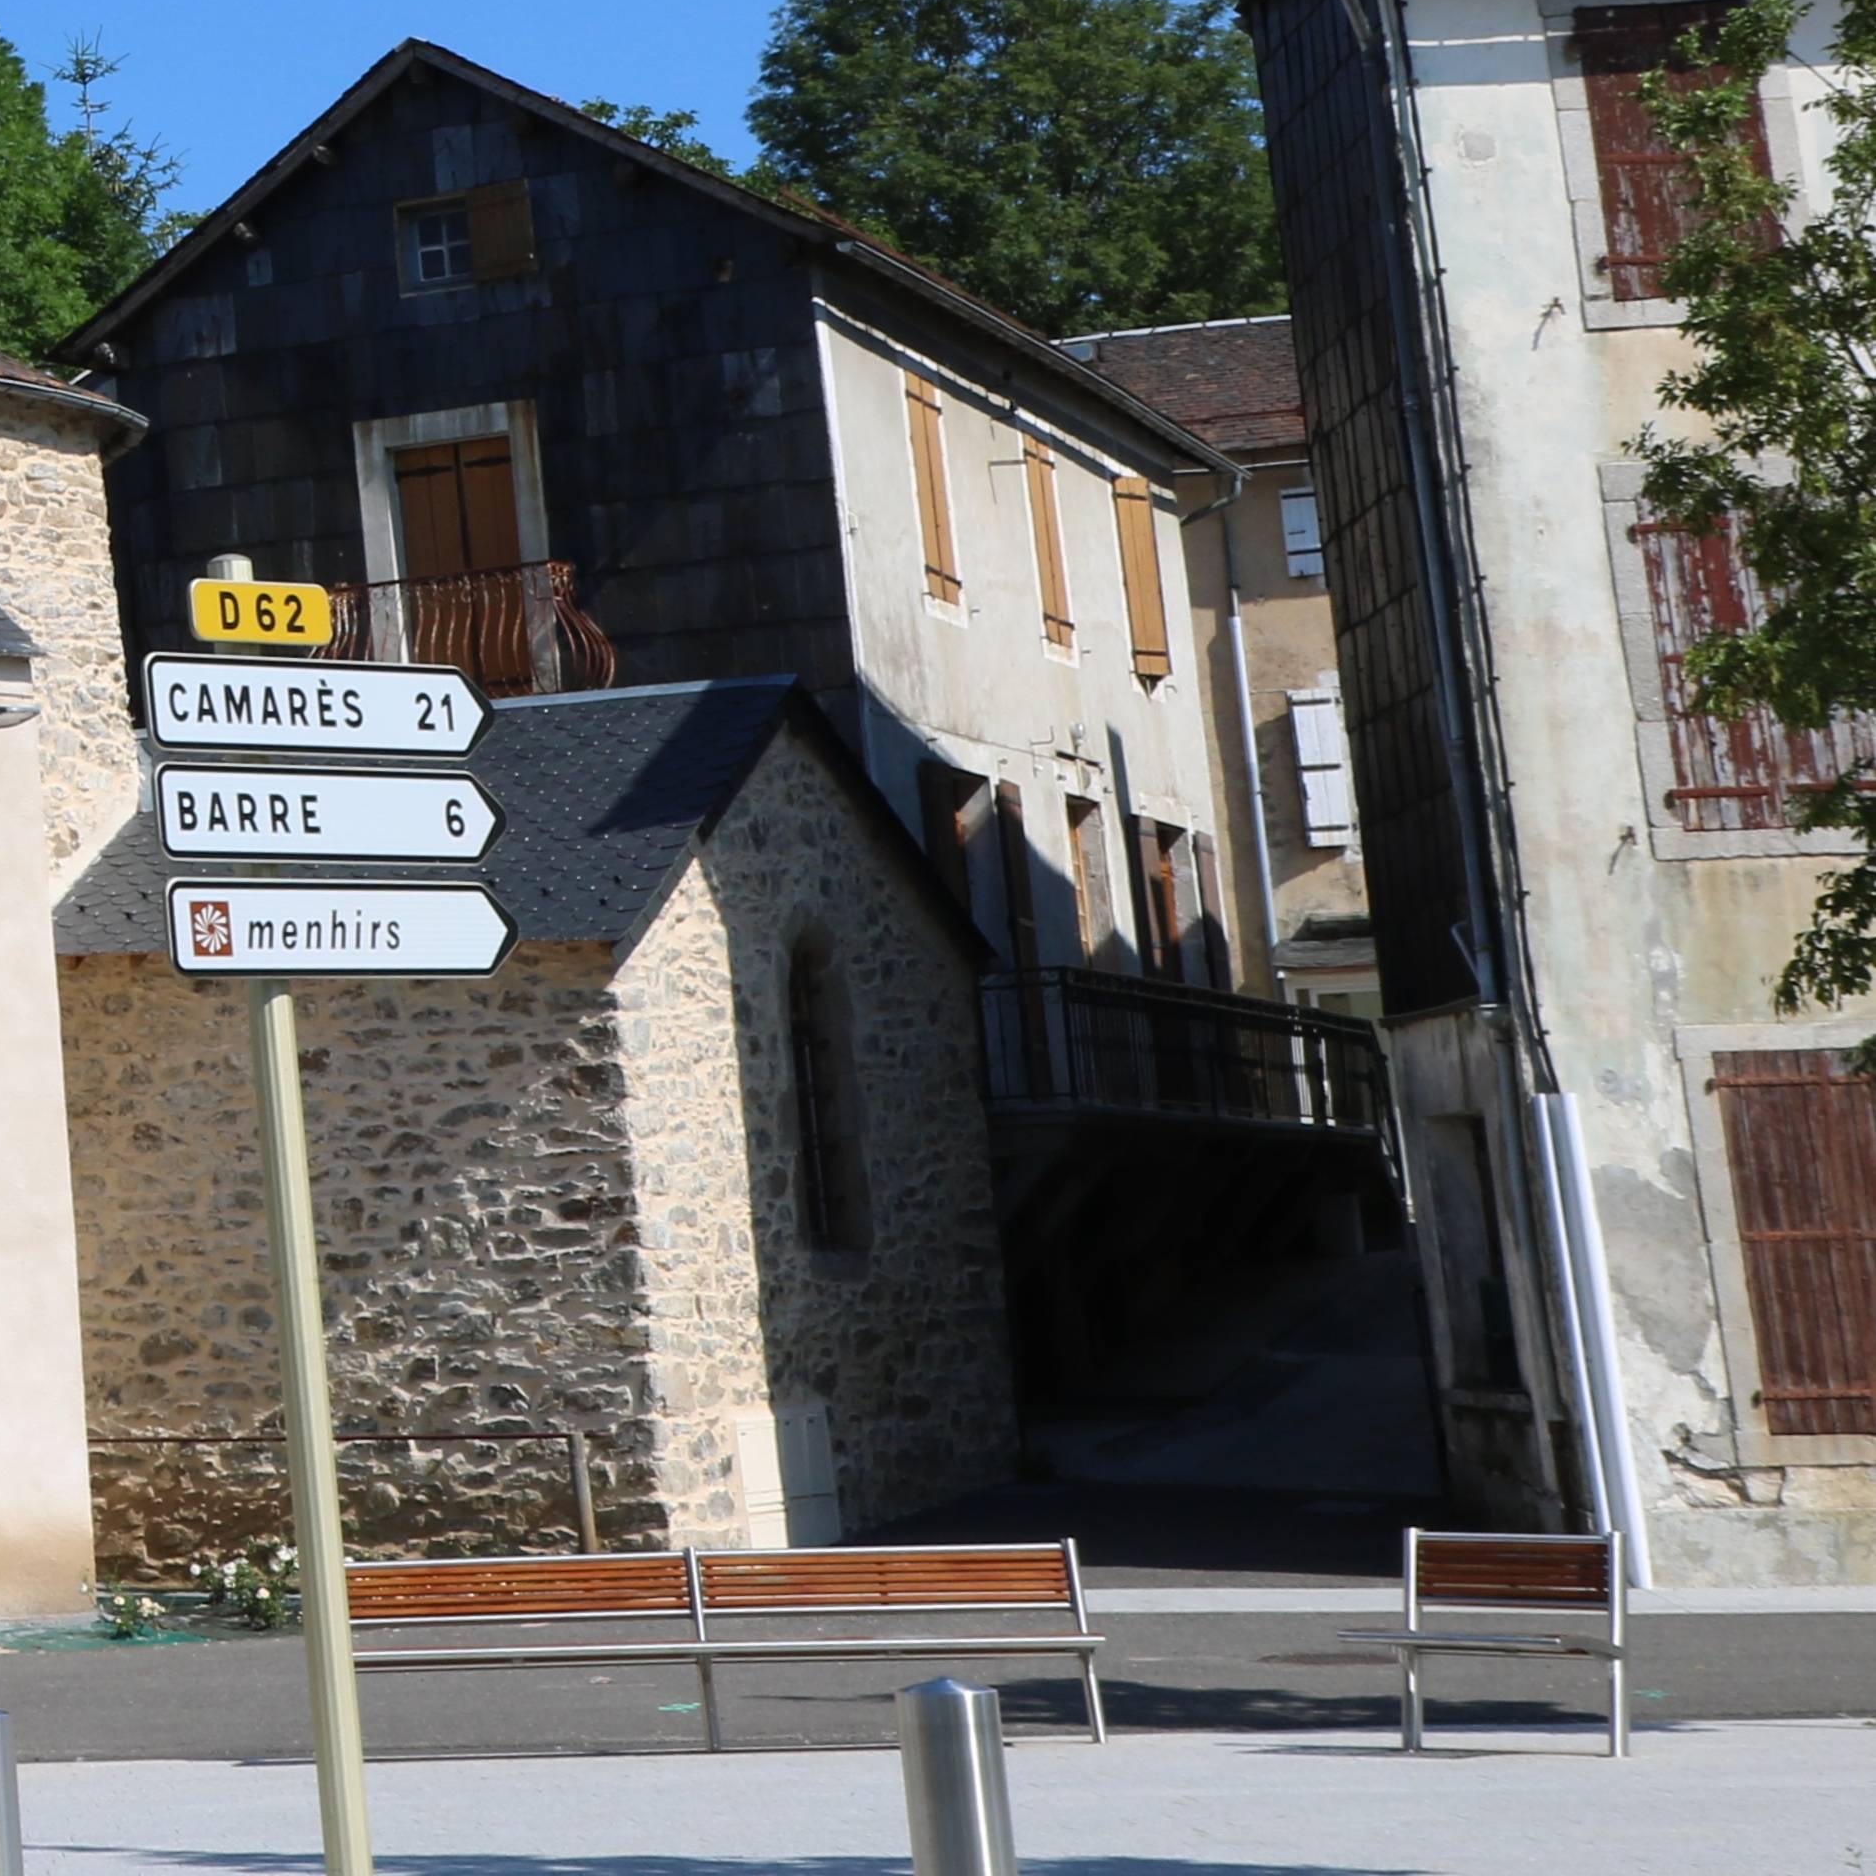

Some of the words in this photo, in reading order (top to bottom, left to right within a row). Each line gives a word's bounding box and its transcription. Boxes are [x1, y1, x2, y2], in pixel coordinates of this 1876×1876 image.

[219, 591, 240, 630] D
[254, 593, 306, 634] 62
[168, 679, 364, 729] CAMARÈS
[414, 692, 455, 732] 21
[176, 790, 322, 835] BARRE
[445, 799, 466, 838] 6
[248, 909, 401, 950] menhirs
